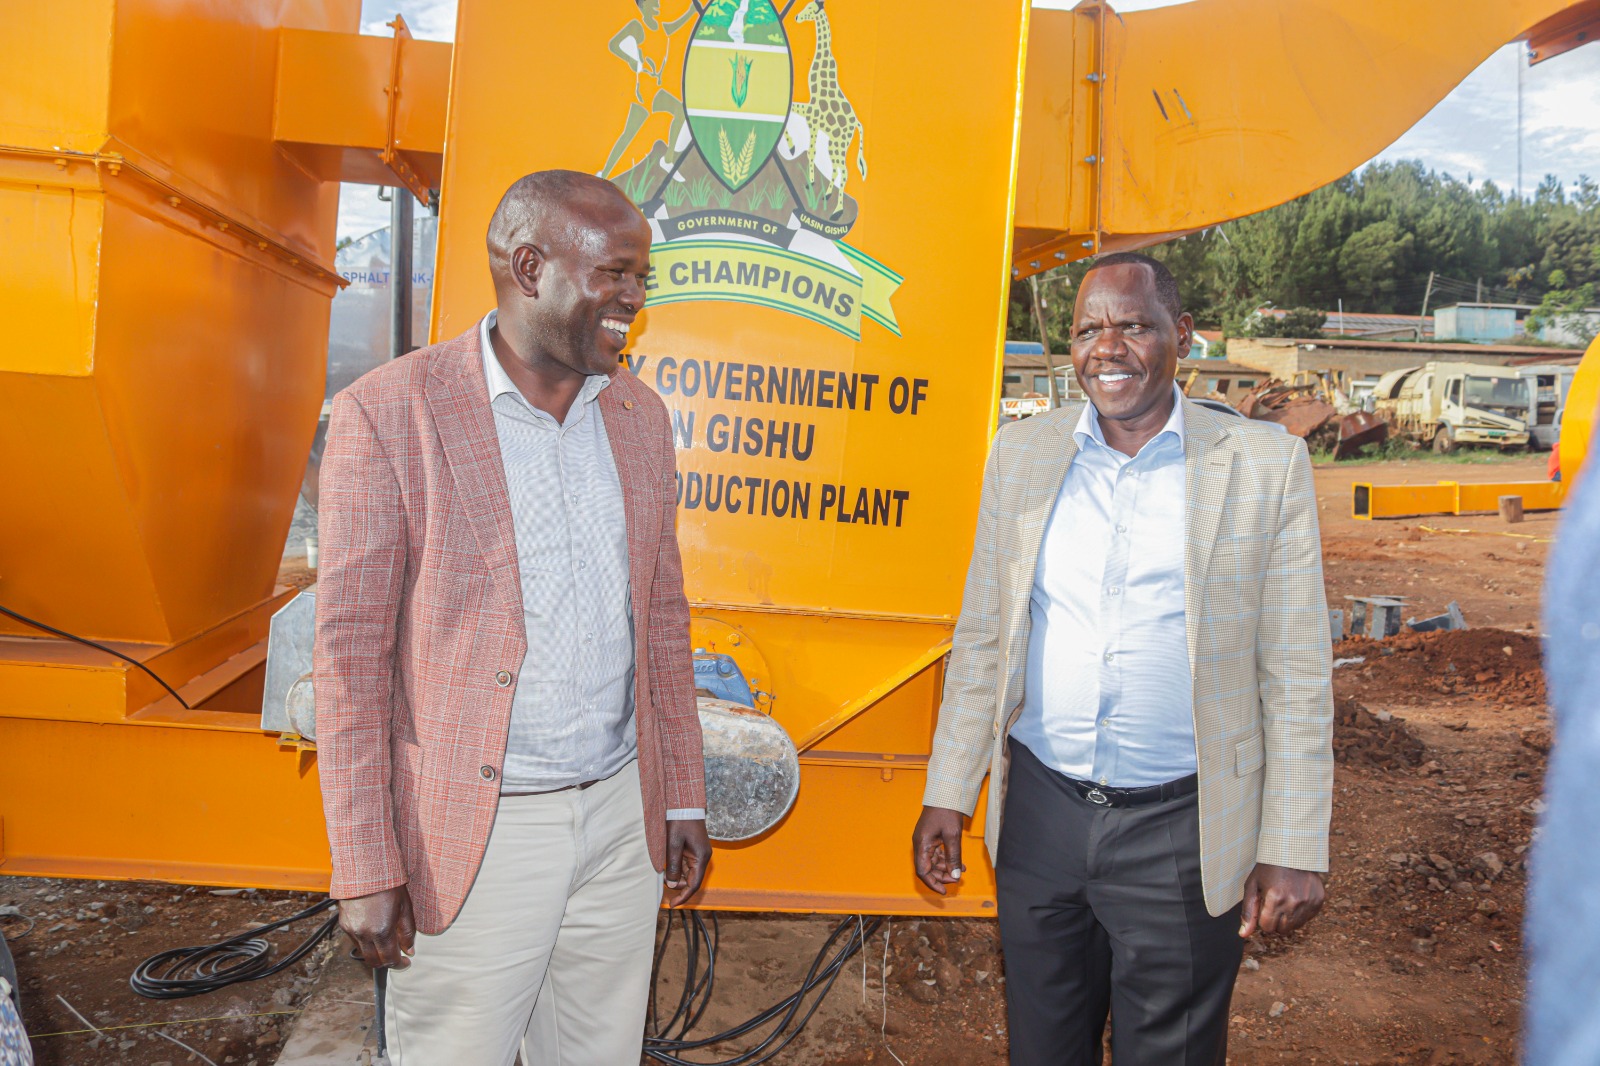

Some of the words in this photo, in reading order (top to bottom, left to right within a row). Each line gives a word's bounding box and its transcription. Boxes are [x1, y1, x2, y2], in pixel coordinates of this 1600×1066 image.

[677, 216, 759, 231] GOVERNMENT
[762, 223, 778, 235] OF
[799, 213, 823, 231] UASIN
[824, 225, 848, 235] GISHU
[336, 271, 390, 284] SPHALT
[669, 260, 854, 318] CHAMPIONS
[656, 356, 879, 411] GOVERNMENT
[888, 376, 929, 415] OF
[706, 413, 815, 461] GISHU
[820, 484, 910, 528] PLANT
